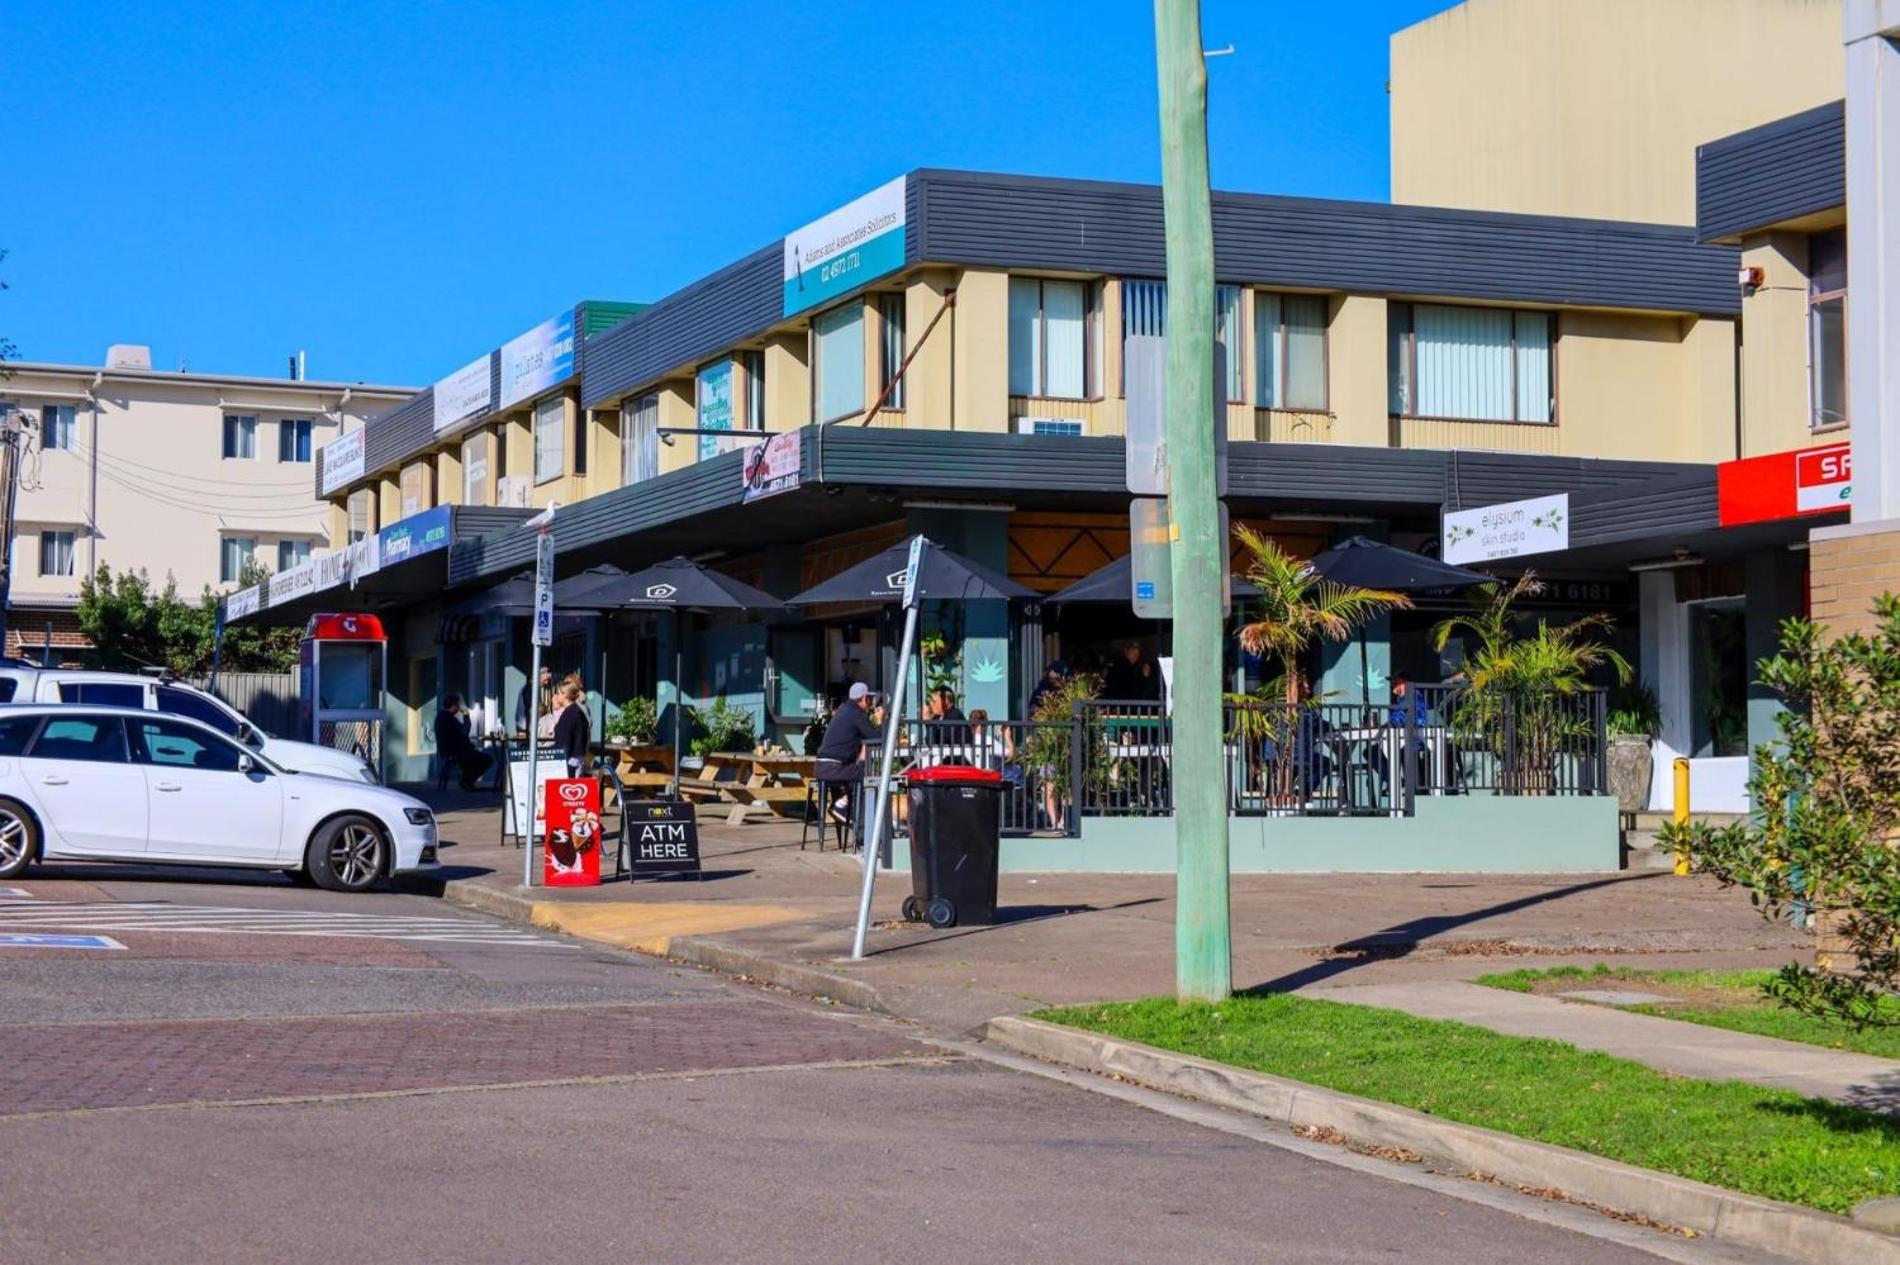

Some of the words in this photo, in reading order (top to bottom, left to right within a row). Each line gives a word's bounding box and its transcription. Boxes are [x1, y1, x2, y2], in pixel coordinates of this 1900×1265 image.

[805, 247, 823, 263] Adams
[824, 238, 835, 255] and
[836, 226, 866, 251] Associates
[1481, 509, 1525, 529] elysium
[1481, 534, 1498, 546] skin
[1500, 530, 1526, 544] studio
[641, 824, 685, 842] ATM
[641, 843, 688, 858] HERE
